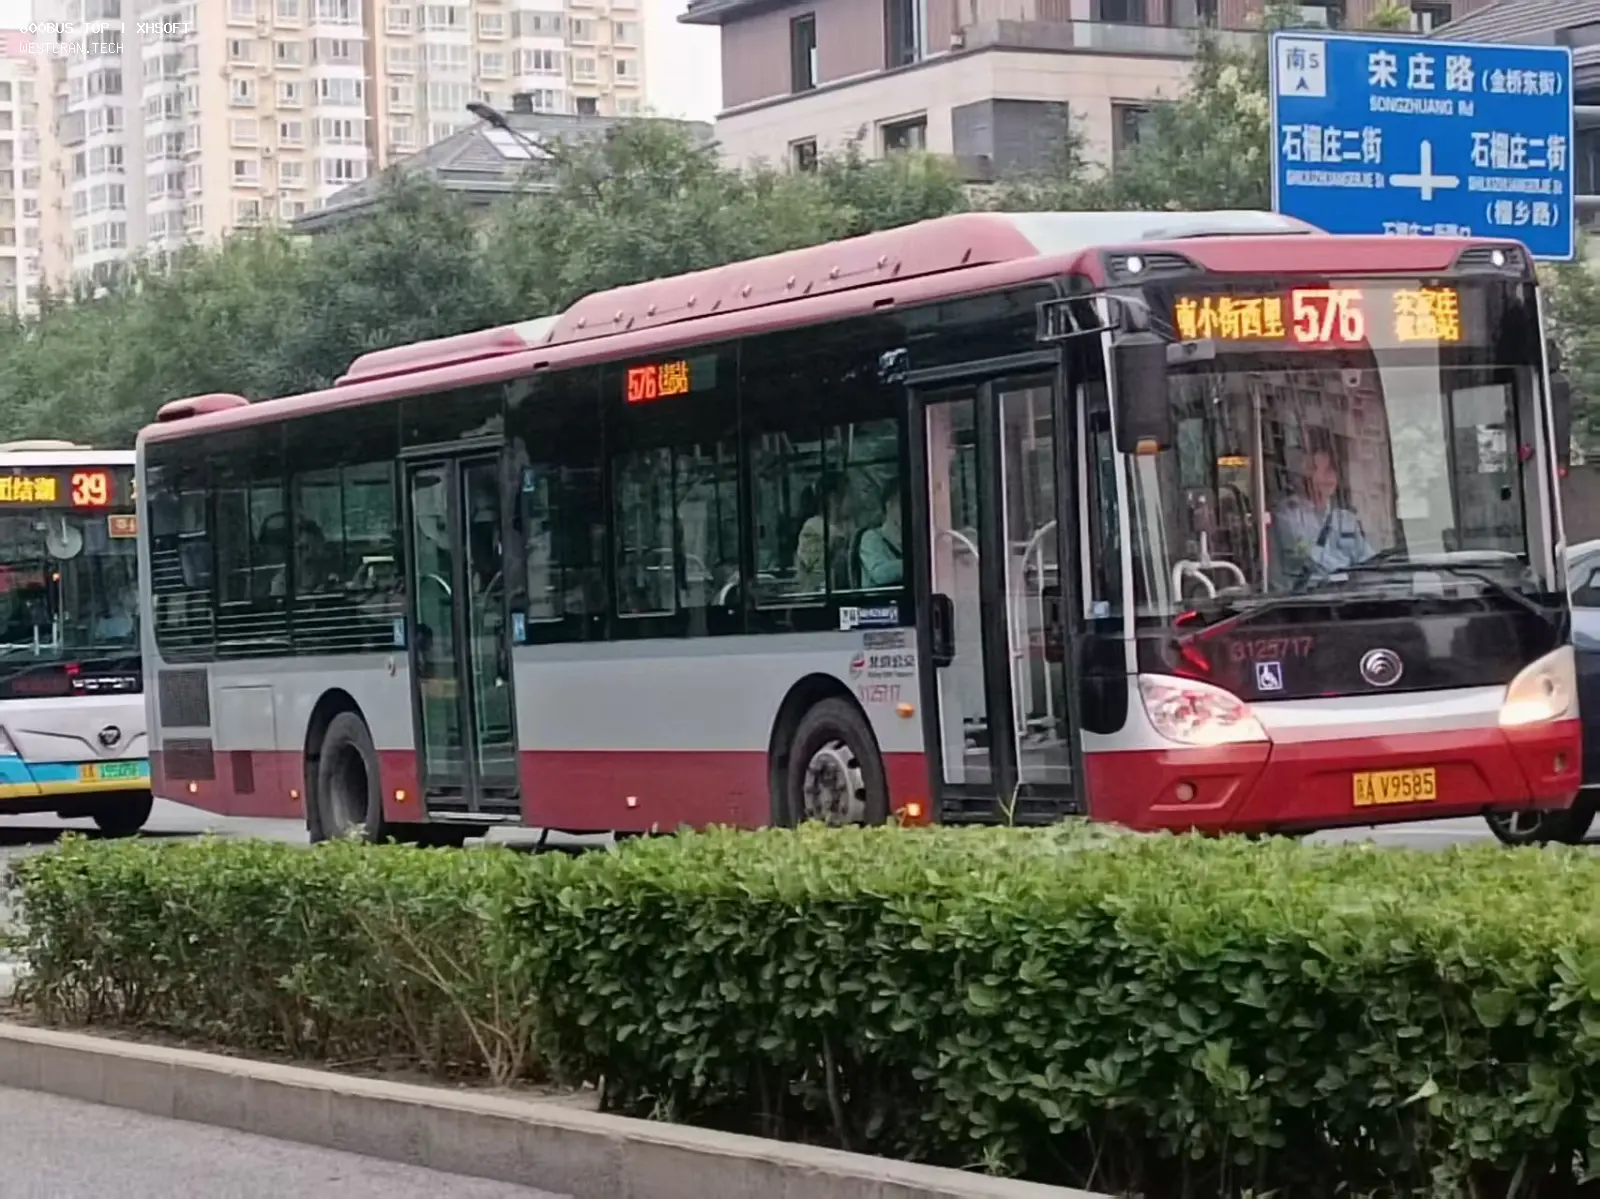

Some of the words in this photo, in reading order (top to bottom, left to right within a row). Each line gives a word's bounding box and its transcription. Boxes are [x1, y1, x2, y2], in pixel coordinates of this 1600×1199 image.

[1368, 50, 1474, 92] 宋庄路
[1292, 288, 1364, 342] 576
[628, 366, 656, 401] 576
[72, 473, 107, 505] 39
